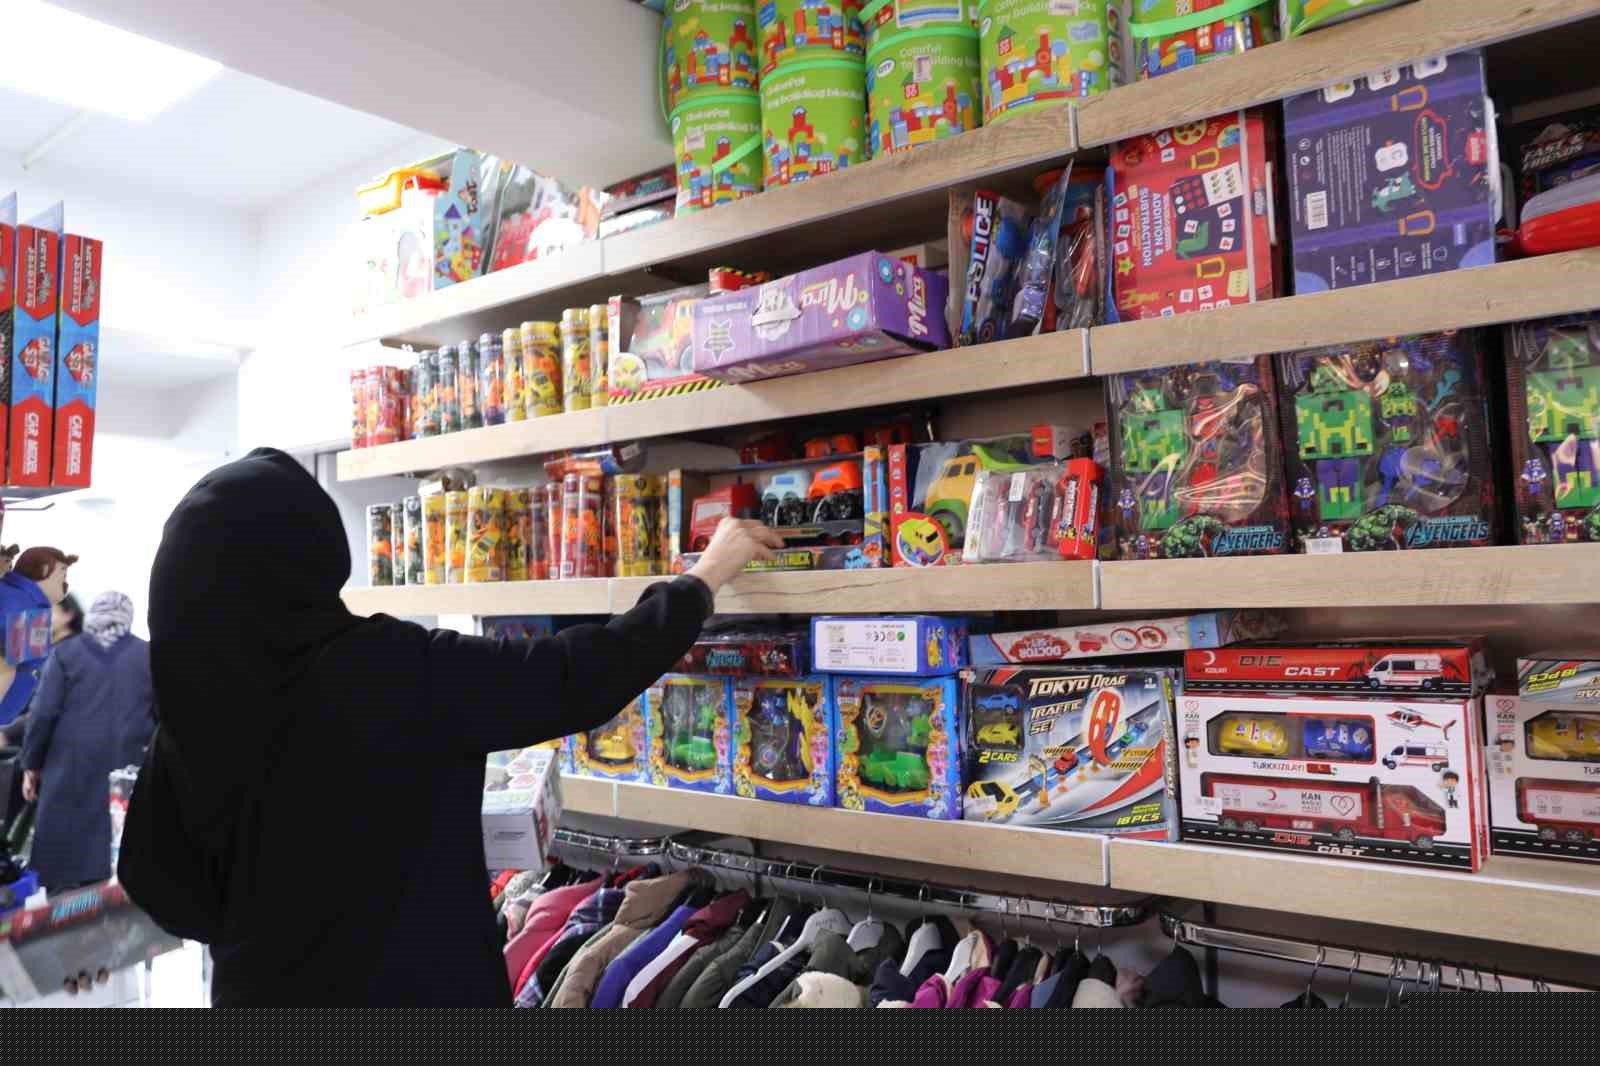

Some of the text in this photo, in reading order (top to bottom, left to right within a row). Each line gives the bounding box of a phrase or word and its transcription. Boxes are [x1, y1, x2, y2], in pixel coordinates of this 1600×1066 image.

[1139, 187, 1153, 266] SUBTRACTION
[1152, 192, 1163, 246] ADDITION
[967, 197, 993, 302] POLICE
[798, 272, 859, 316] Mira
[906, 276, 929, 336] Mira
[1212, 529, 1282, 556] AVENGERS
[1405, 520, 1489, 548] AVENGERS
[1018, 645, 1062, 657] DOCTOR
[1239, 655, 1341, 677] DIE CAST
[1528, 670, 1560, 683] PCS
[1029, 675, 1092, 700] TOKYO
[1090, 673, 1128, 688] DRAG
[1031, 698, 1084, 719] TRAFFIC
[1030, 718, 1056, 737] SET
[978, 751, 1018, 764] 2 CARS
[1301, 791, 1321, 801] KAN
[1130, 813, 1161, 824] PCS
[1316, 845, 1365, 857] CAST
